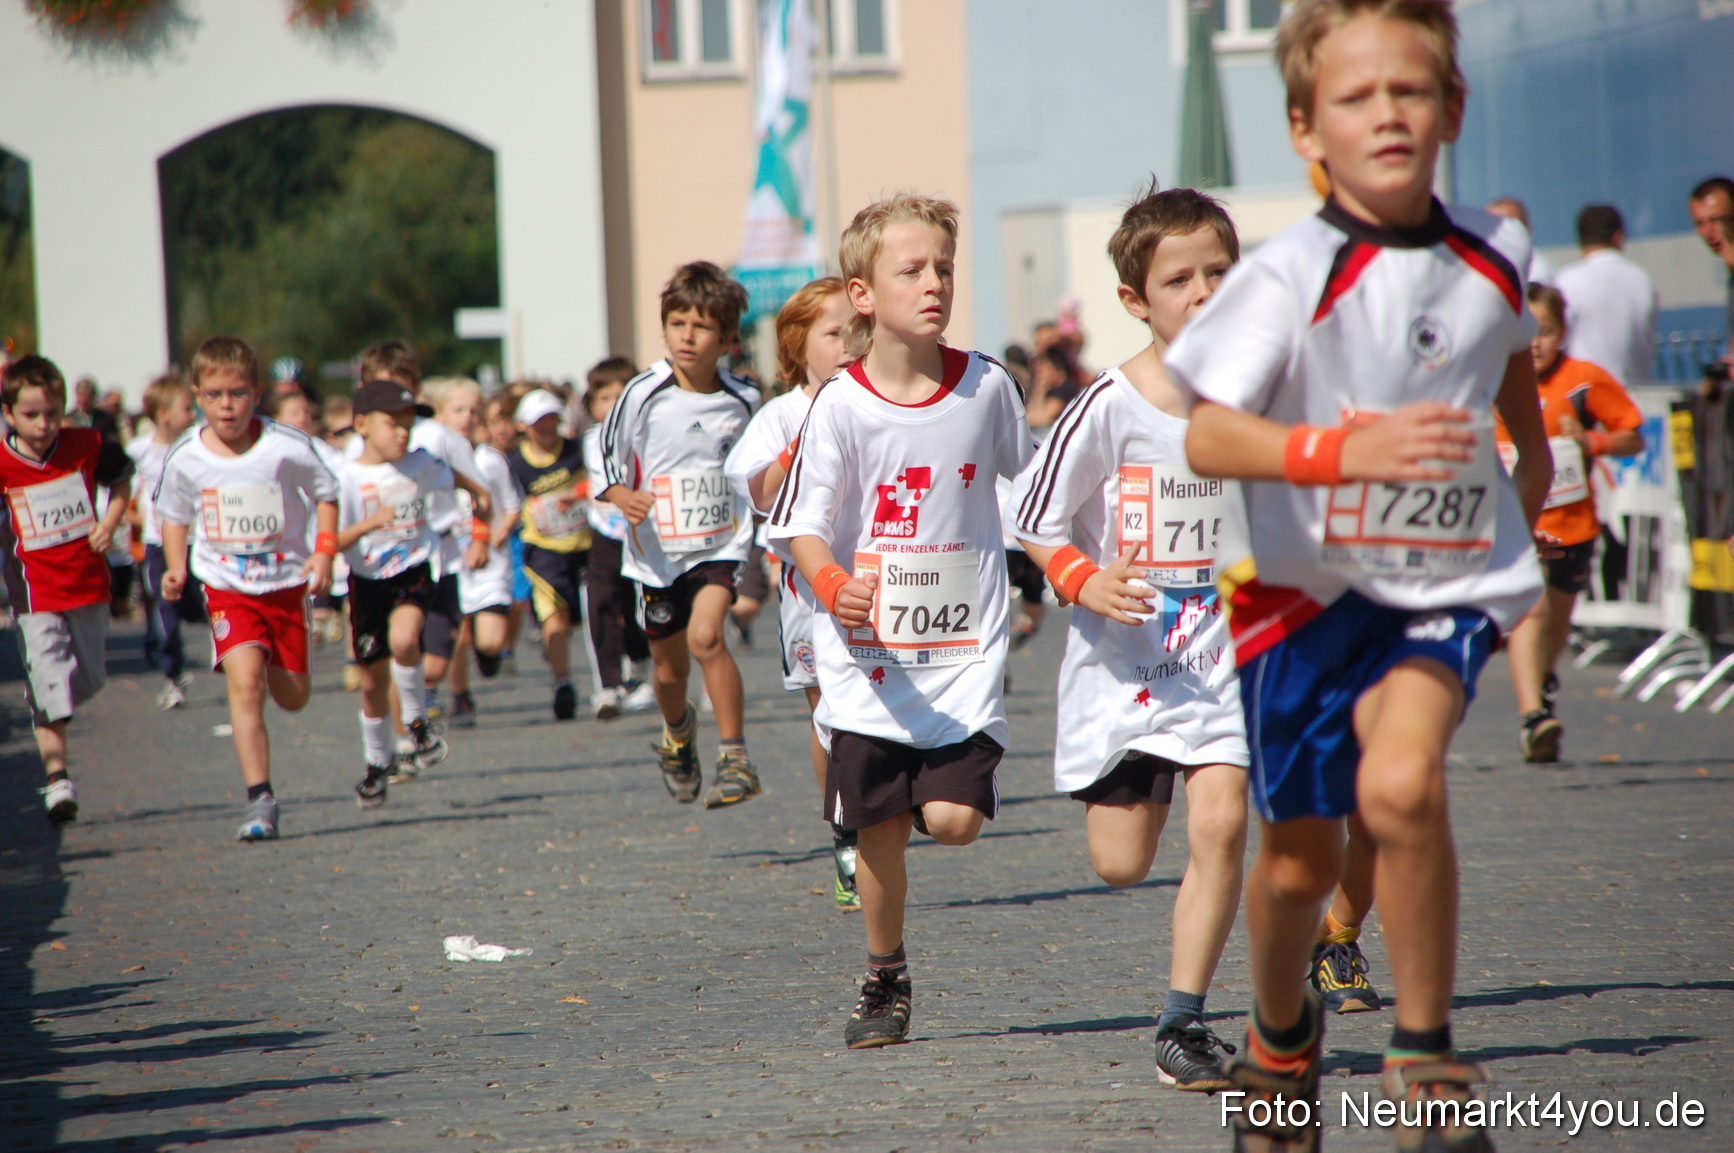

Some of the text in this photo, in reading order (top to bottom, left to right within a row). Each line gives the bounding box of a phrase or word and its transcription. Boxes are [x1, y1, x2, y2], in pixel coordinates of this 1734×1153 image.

[681, 475, 732, 502] PAUL
[1160, 476, 1222, 499] Manuel
[222, 493, 243, 506] Luis
[1380, 483, 1488, 530] 7287
[38, 500, 86, 528] 7294
[226, 513, 279, 534] 7060
[681, 501, 731, 528] 7296
[1125, 512, 1143, 531] K2
[873, 519, 915, 537] DKMS
[1163, 517, 1222, 554] 715
[900, 543, 940, 554] EINZELNE
[942, 541, 965, 553] ZÄHLT
[888, 564, 940, 586] Simon
[889, 603, 971, 636] 7042
[849, 646, 899, 661] BOCK
[930, 646, 981, 658] PFLEIDERER
